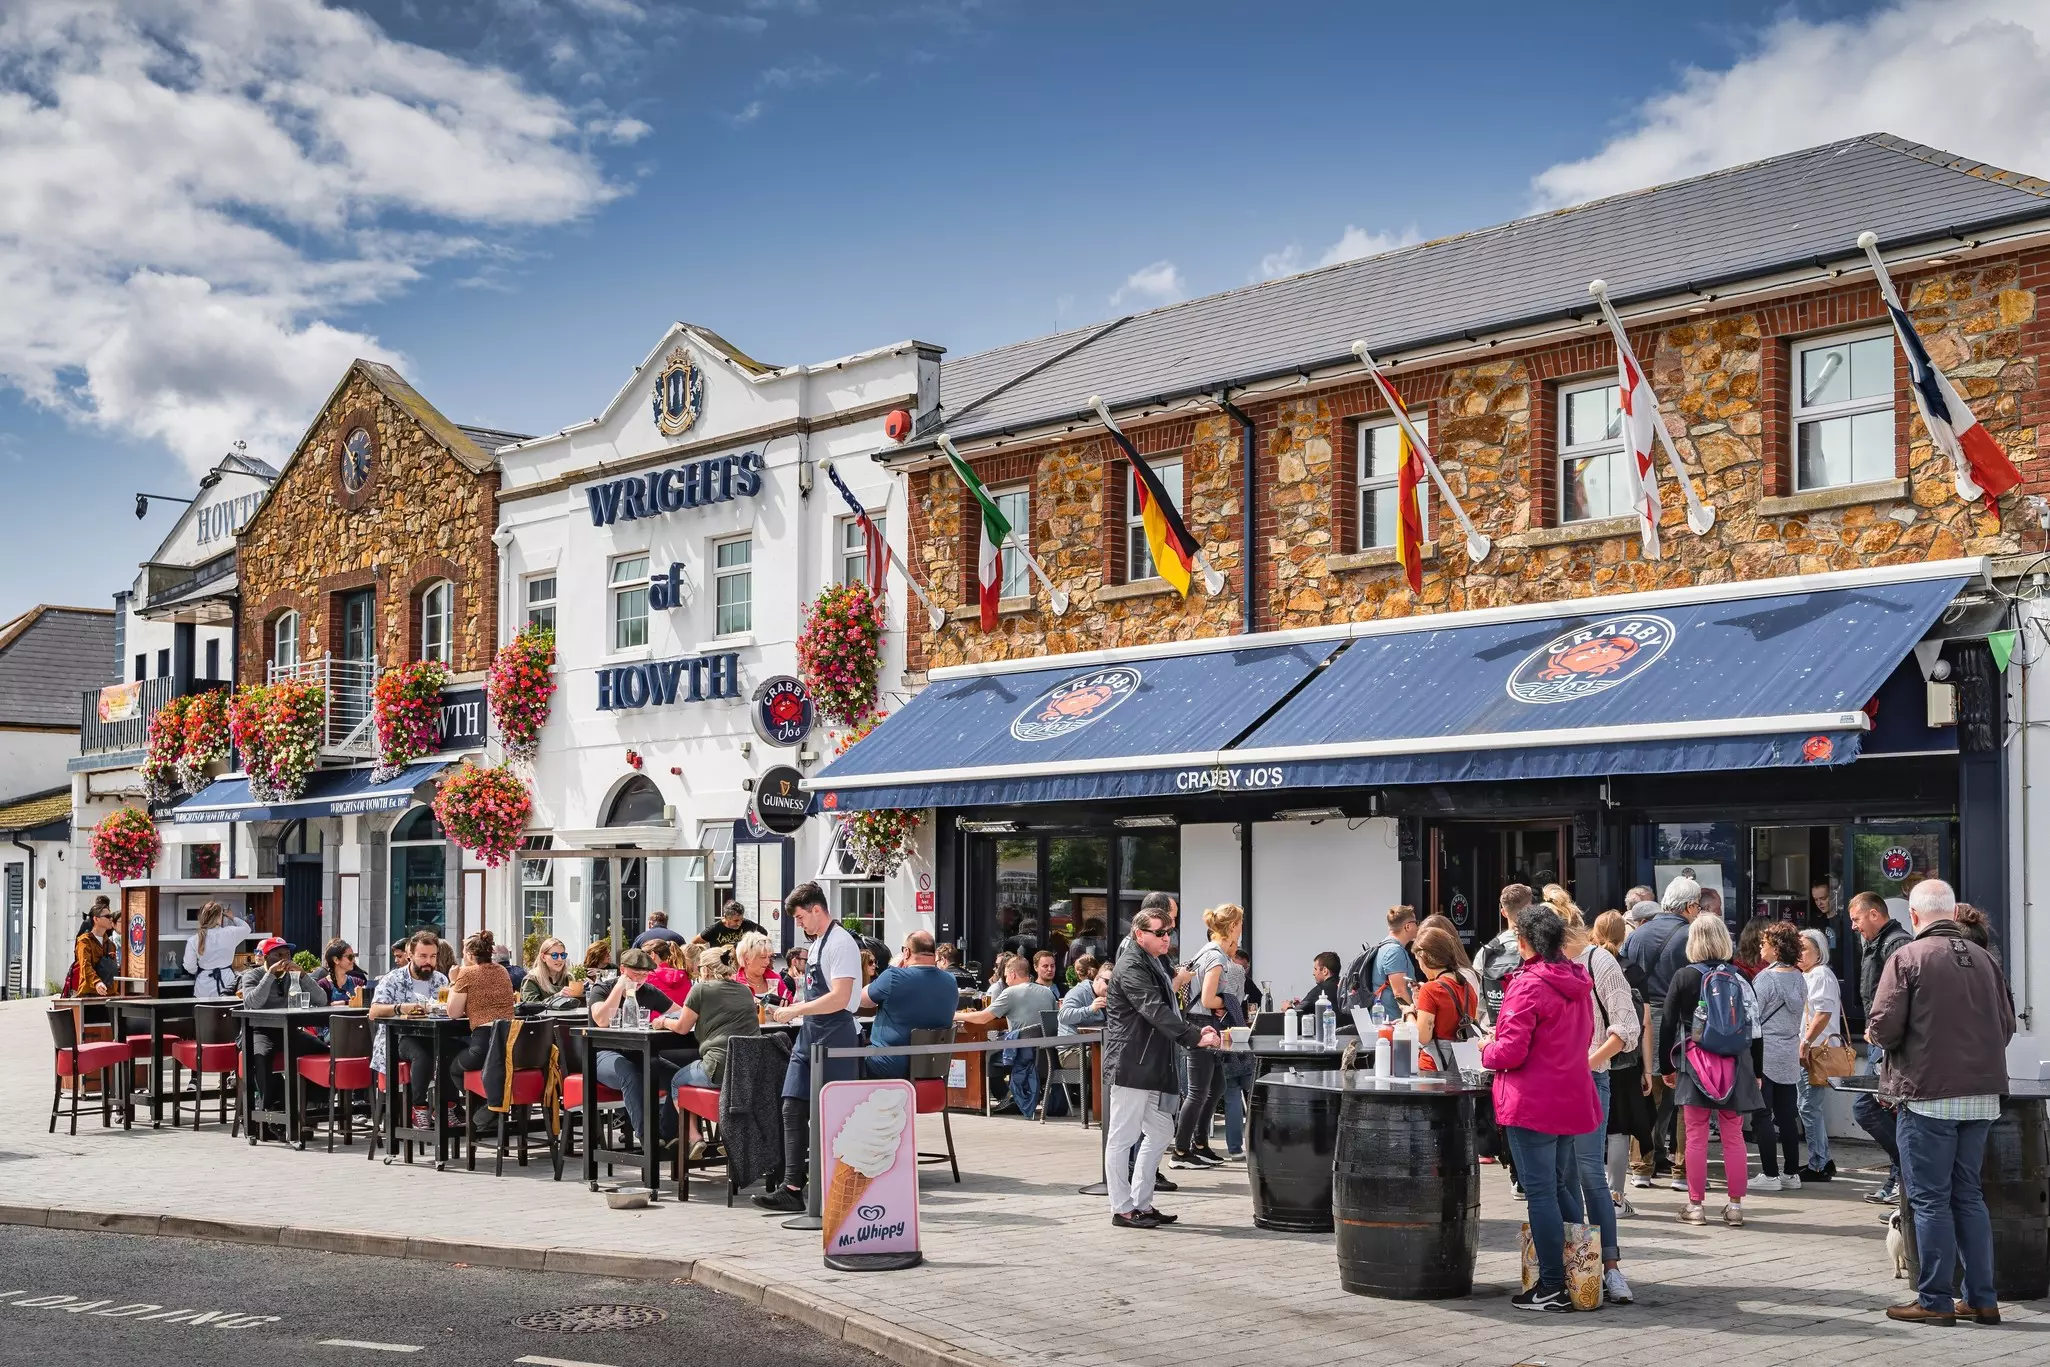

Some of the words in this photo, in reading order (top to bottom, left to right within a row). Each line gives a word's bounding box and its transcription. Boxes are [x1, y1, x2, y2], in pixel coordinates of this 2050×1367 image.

[584, 451, 762, 527] WRIGHTS
[648, 561, 687, 611] of
[1549, 622, 1661, 654] CRABBY
[594, 652, 743, 711] HOWTH
[764, 681, 810, 706] CRABBY
[1052, 673, 1130, 700] CRABBY
[778, 721, 801, 740] Jo's
[1176, 769, 1241, 790] CRABBY
[1245, 766, 1283, 787] JO'S
[763, 793, 804, 810] GUINNESS
[1660, 835, 1715, 852] Menu
[1884, 849, 1910, 860] CRABBY
[1487, 990, 1505, 999] adid
[838, 1234, 856, 1248] Mr.
[857, 1221, 905, 1242] Whippy
